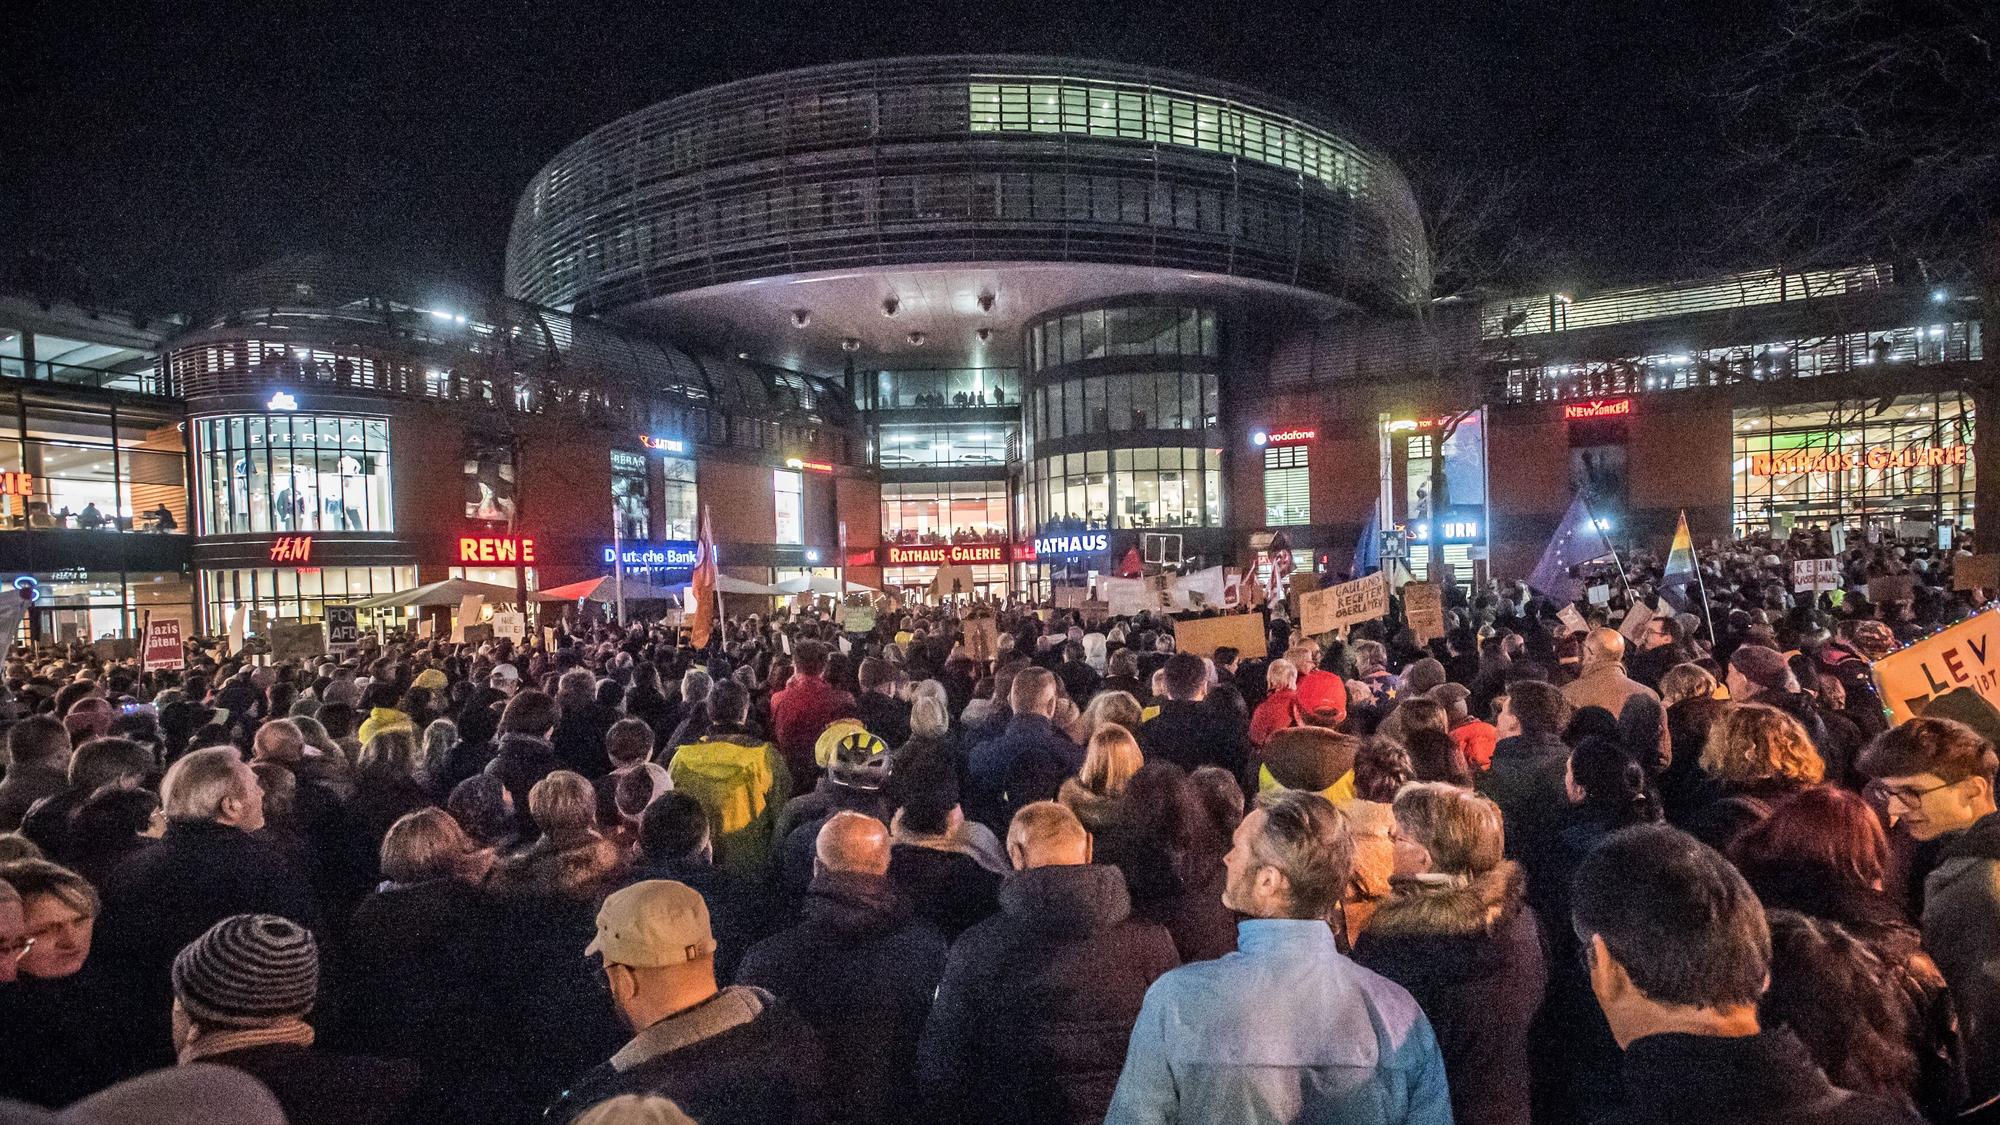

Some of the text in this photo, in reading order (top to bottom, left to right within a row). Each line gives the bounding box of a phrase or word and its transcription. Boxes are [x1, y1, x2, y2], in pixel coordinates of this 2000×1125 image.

[251, 433, 363, 443] ETERNA
[1269, 430, 1315, 441] vodafone
[1418, 523, 1477, 538] SURN
[271, 536, 312, 561] H&M
[460, 538, 535, 562] REWE
[1034, 534, 1108, 554] RATHAUS
[604, 548, 697, 563] Dutsche Bank
[1796, 560, 1832, 574] KEIN
[330, 609, 355, 622] FCK
